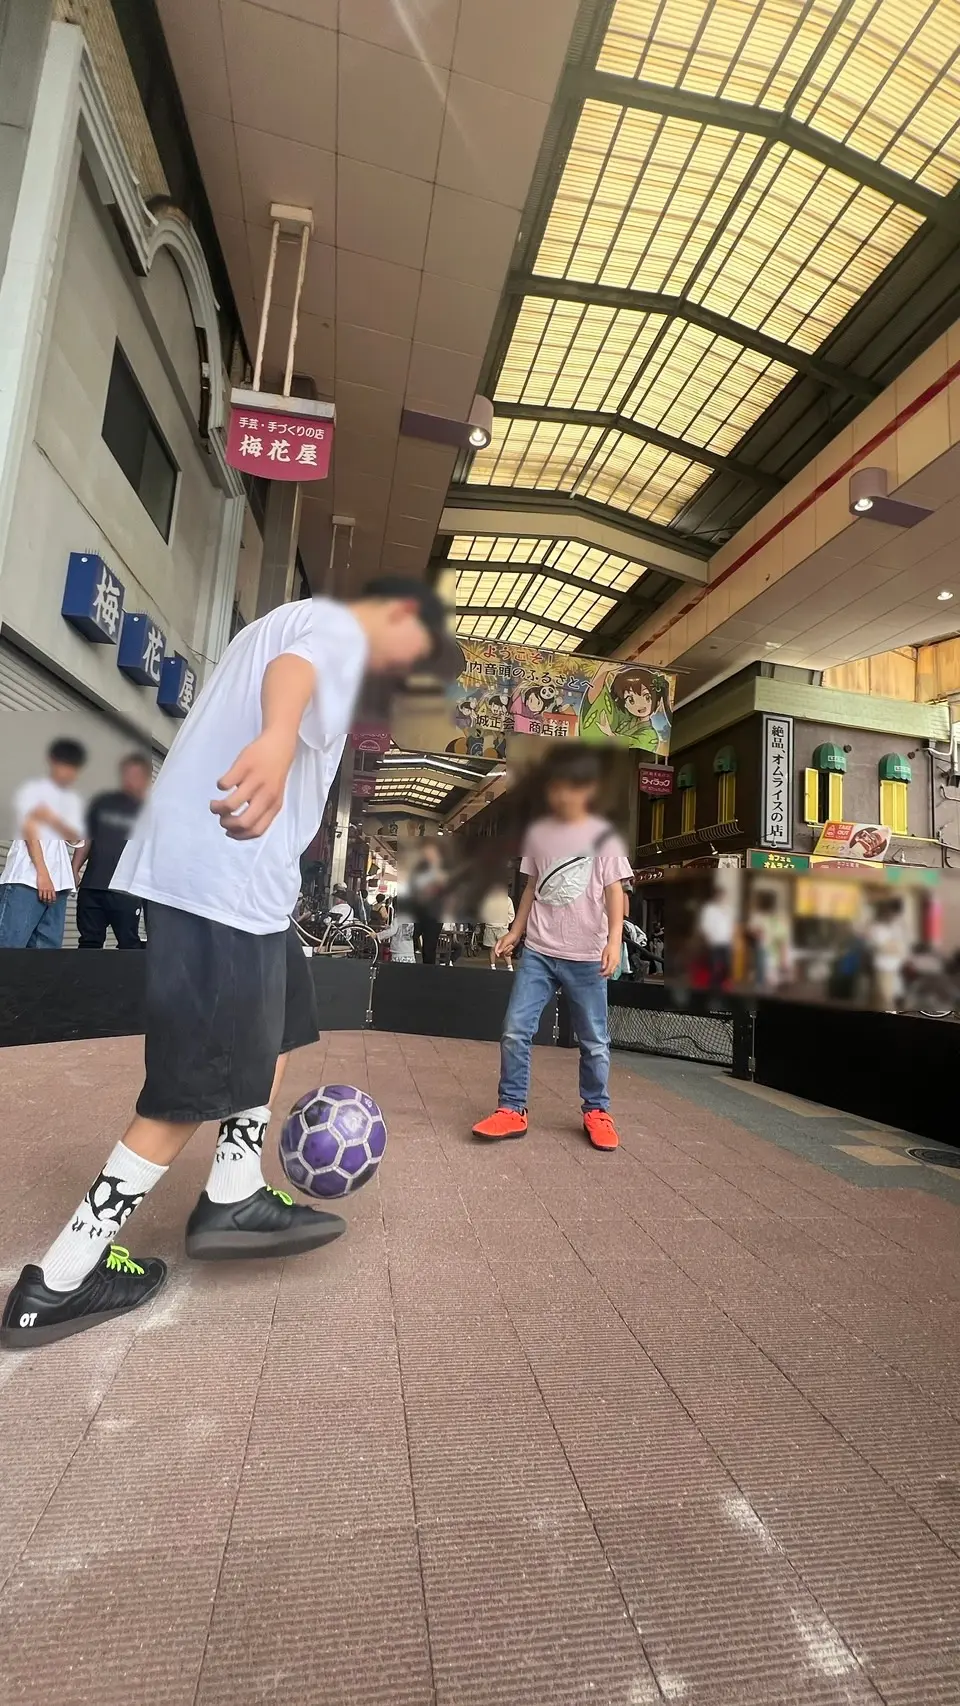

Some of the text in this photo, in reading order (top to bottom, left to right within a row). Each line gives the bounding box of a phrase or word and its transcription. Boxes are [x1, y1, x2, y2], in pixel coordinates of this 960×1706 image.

[239, 417, 325, 440] 手芸・手づくりの店
[239, 434, 318, 466] 梅花屋
[92, 566, 121, 635] 梅
[143, 626, 163, 682] 花
[465, 660, 595, 689] 内音頭のふるさとへ
[769, 725, 786, 838] 絶品、オムライスの店
[19, 1312, 38, 1328] OT
